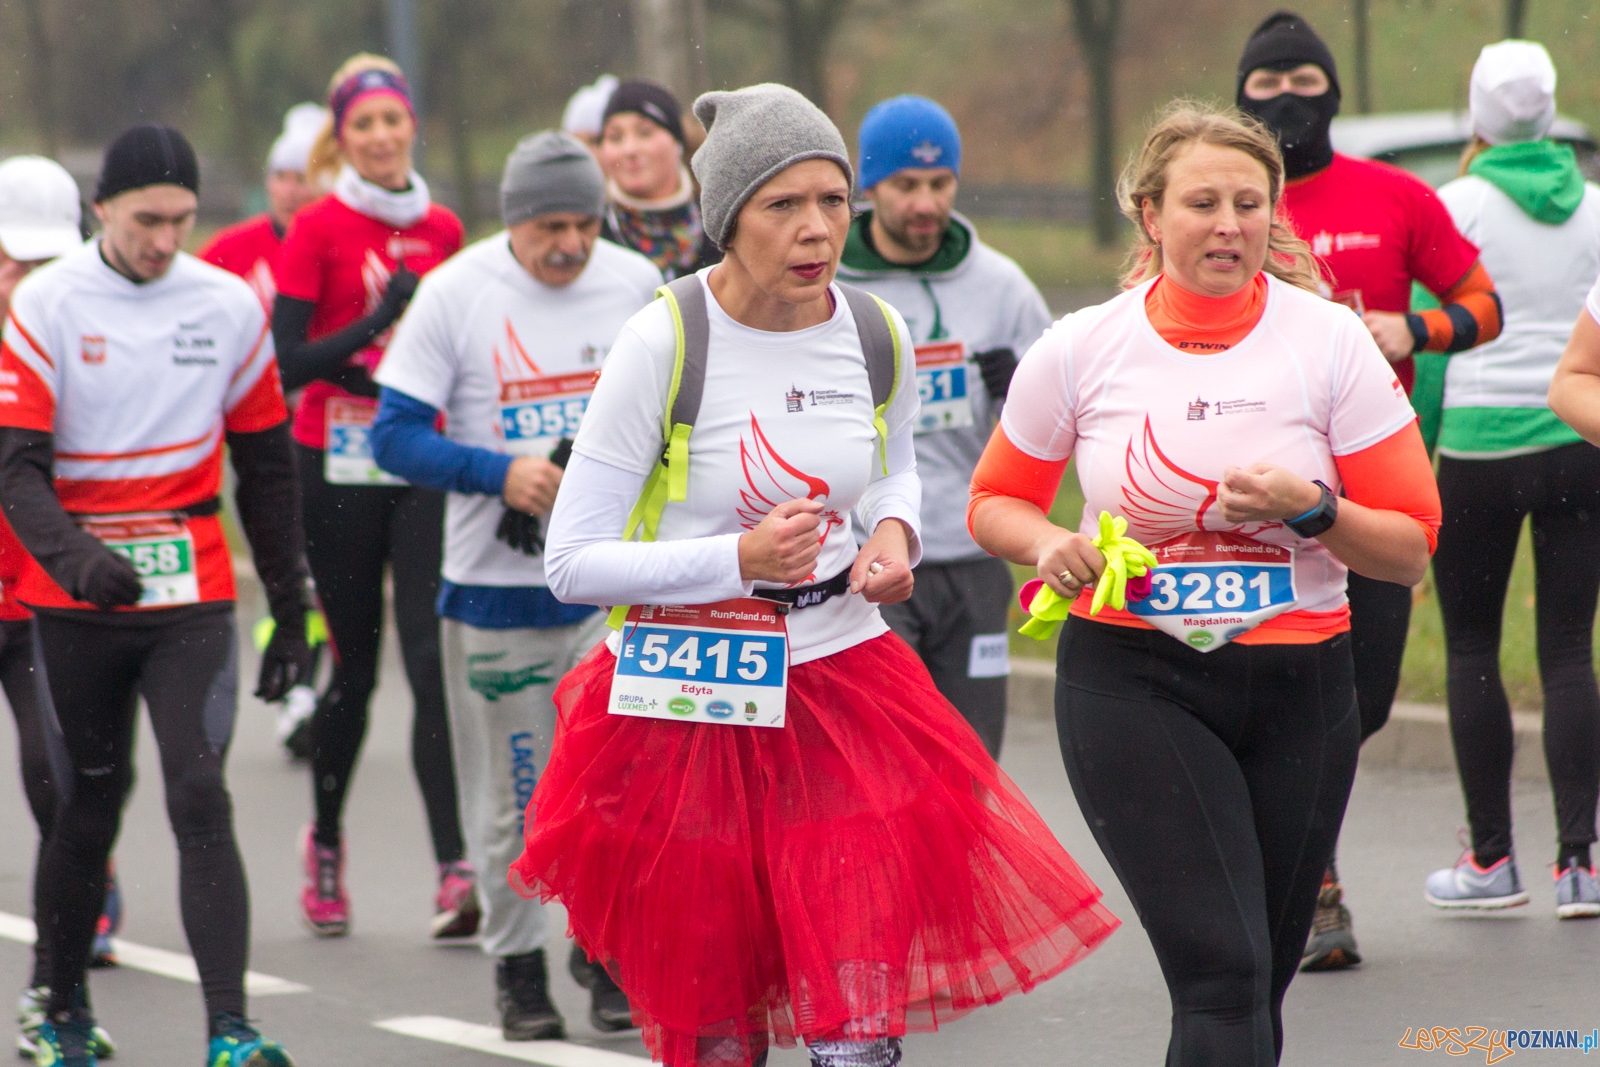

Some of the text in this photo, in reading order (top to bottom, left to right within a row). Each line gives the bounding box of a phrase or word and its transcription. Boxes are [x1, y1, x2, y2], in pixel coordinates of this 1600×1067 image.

[808, 390, 817, 406] 1
[1214, 401, 1223, 415] 1
[1215, 544, 1281, 555] RunPoland.org
[113, 543, 181, 575] 58
[1150, 571, 1271, 611] 3281
[710, 609, 776, 624] RunPoland.org
[1183, 617, 1243, 628] Magdalena
[624, 634, 768, 681] E 5415
[681, 684, 713, 696] Edyta
[619, 694, 644, 703] GRUPA
[618, 702, 648, 711] LUXMED
[510, 732, 537, 835] LACOS
